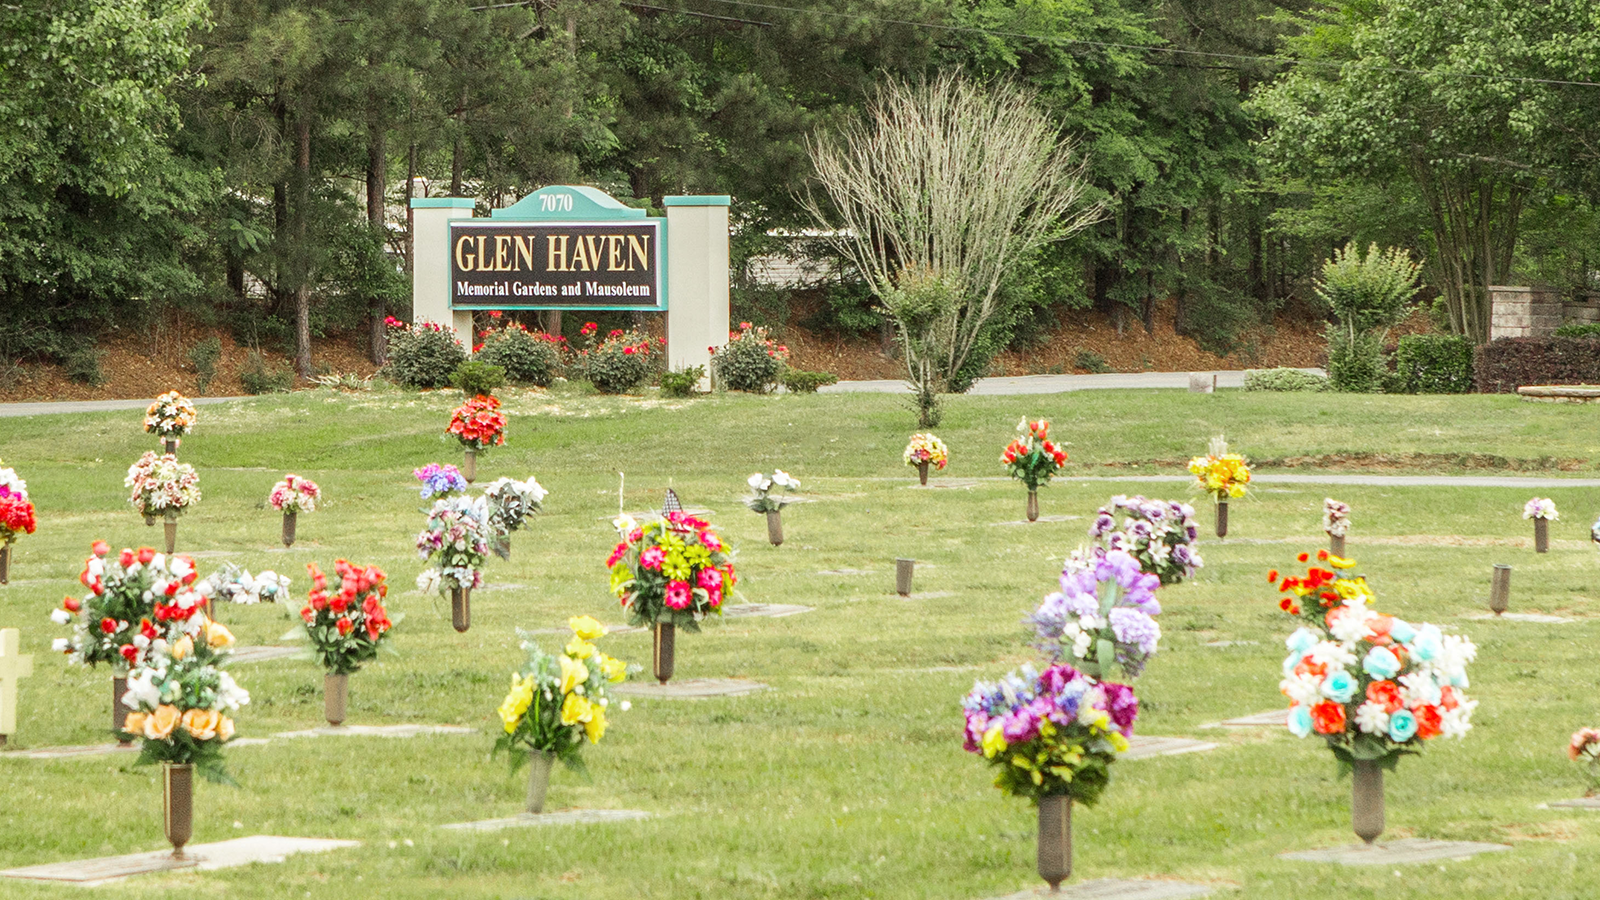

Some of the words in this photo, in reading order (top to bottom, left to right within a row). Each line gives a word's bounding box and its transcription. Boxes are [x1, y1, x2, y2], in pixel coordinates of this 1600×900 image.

[539, 194, 573, 212] 7070
[455, 235, 535, 272] GLEN
[546, 235, 650, 272] HAVEN
[456, 281, 509, 296] Memorial
[513, 281, 557, 296] Gardens
[561, 281, 581, 296] and
[585, 281, 650, 296] Mausoleum
